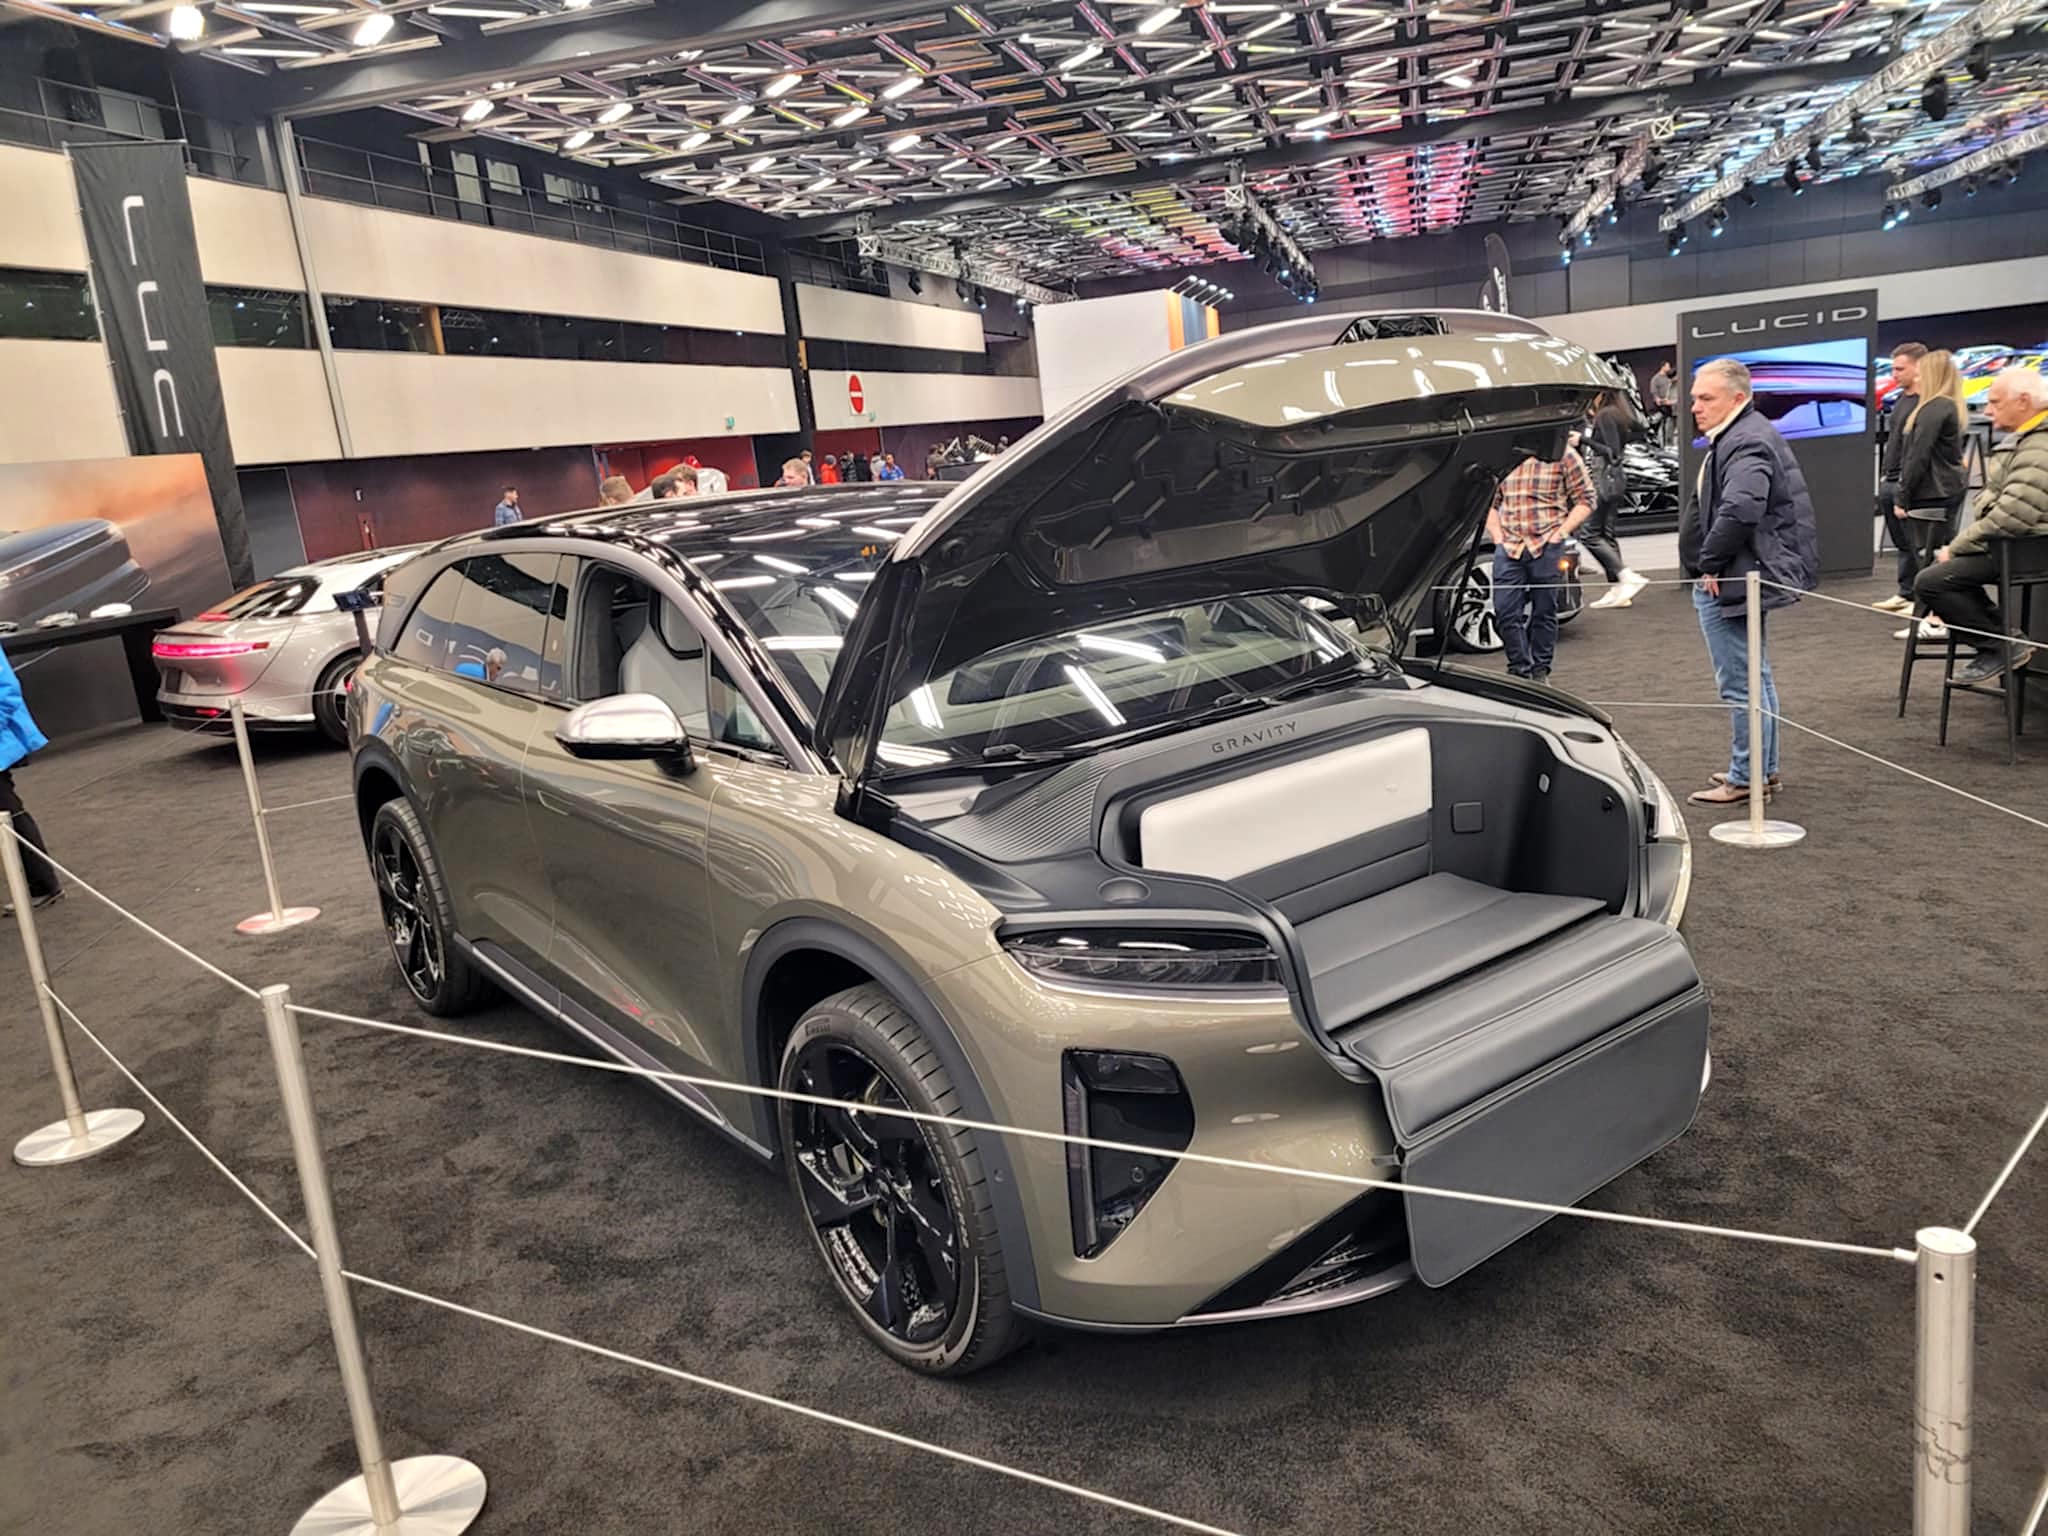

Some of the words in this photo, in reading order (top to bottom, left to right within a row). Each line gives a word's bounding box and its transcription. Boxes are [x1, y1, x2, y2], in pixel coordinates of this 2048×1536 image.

[122, 195, 185, 438] LUC
[1691, 306, 1869, 339] LUCID
[1211, 720, 1297, 754] GRAVITY
